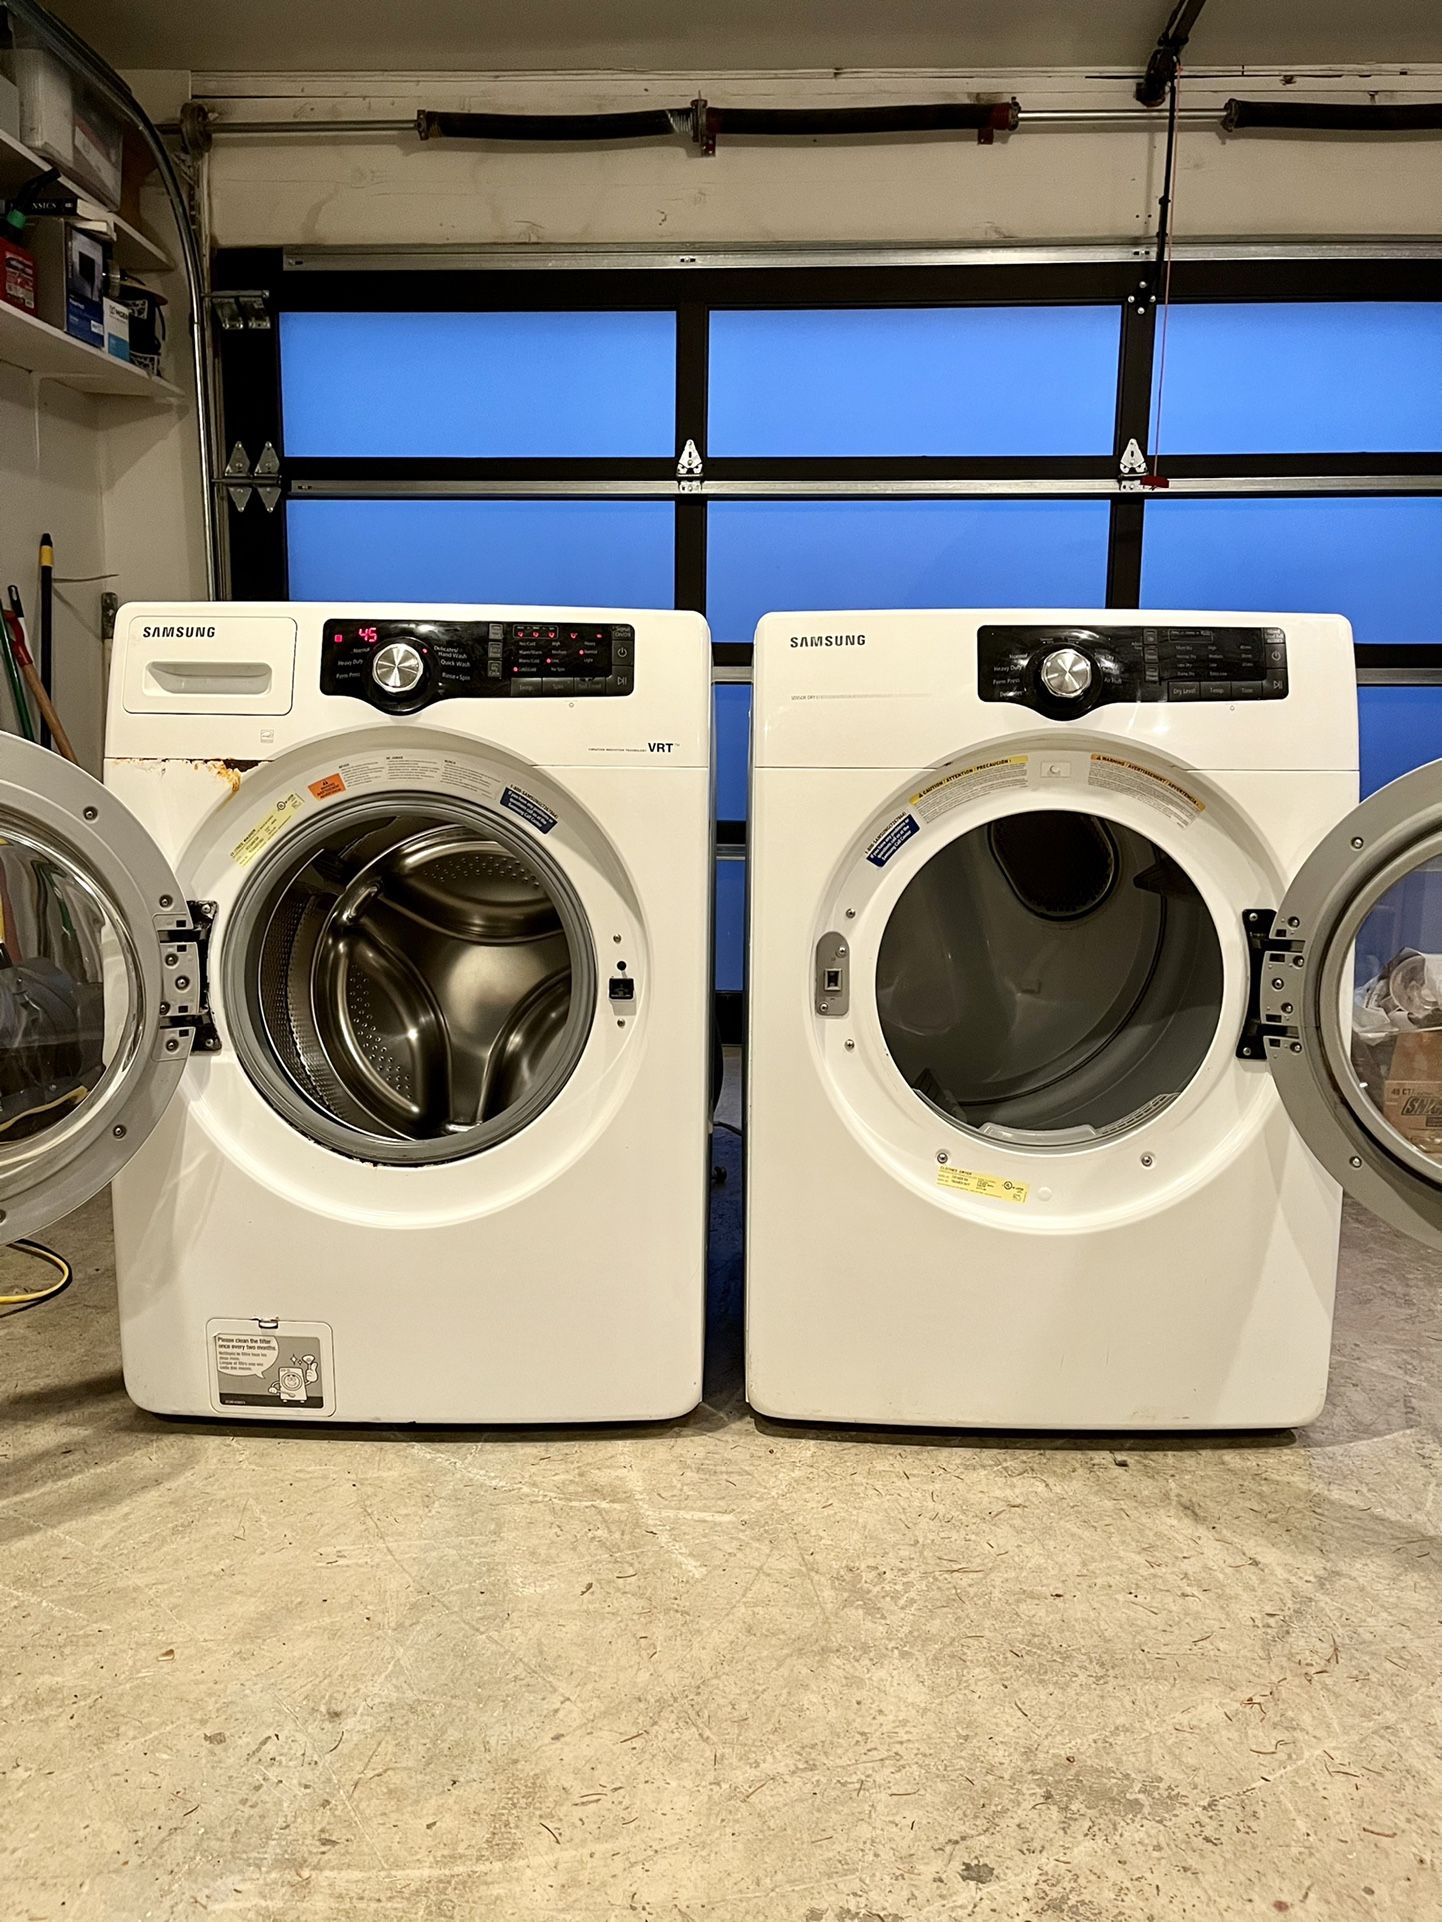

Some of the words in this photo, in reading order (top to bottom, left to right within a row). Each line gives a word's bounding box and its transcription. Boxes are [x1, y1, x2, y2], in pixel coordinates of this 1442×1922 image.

[143, 626, 216, 638] SAMSUNG
[358, 628, 377, 642] 45
[790, 634, 866, 648] SAMSUNG
[1173, 688, 1182, 696] Dry
[946, 768, 974, 782] ATTENTION
[922, 780, 944, 795] CAUTION
